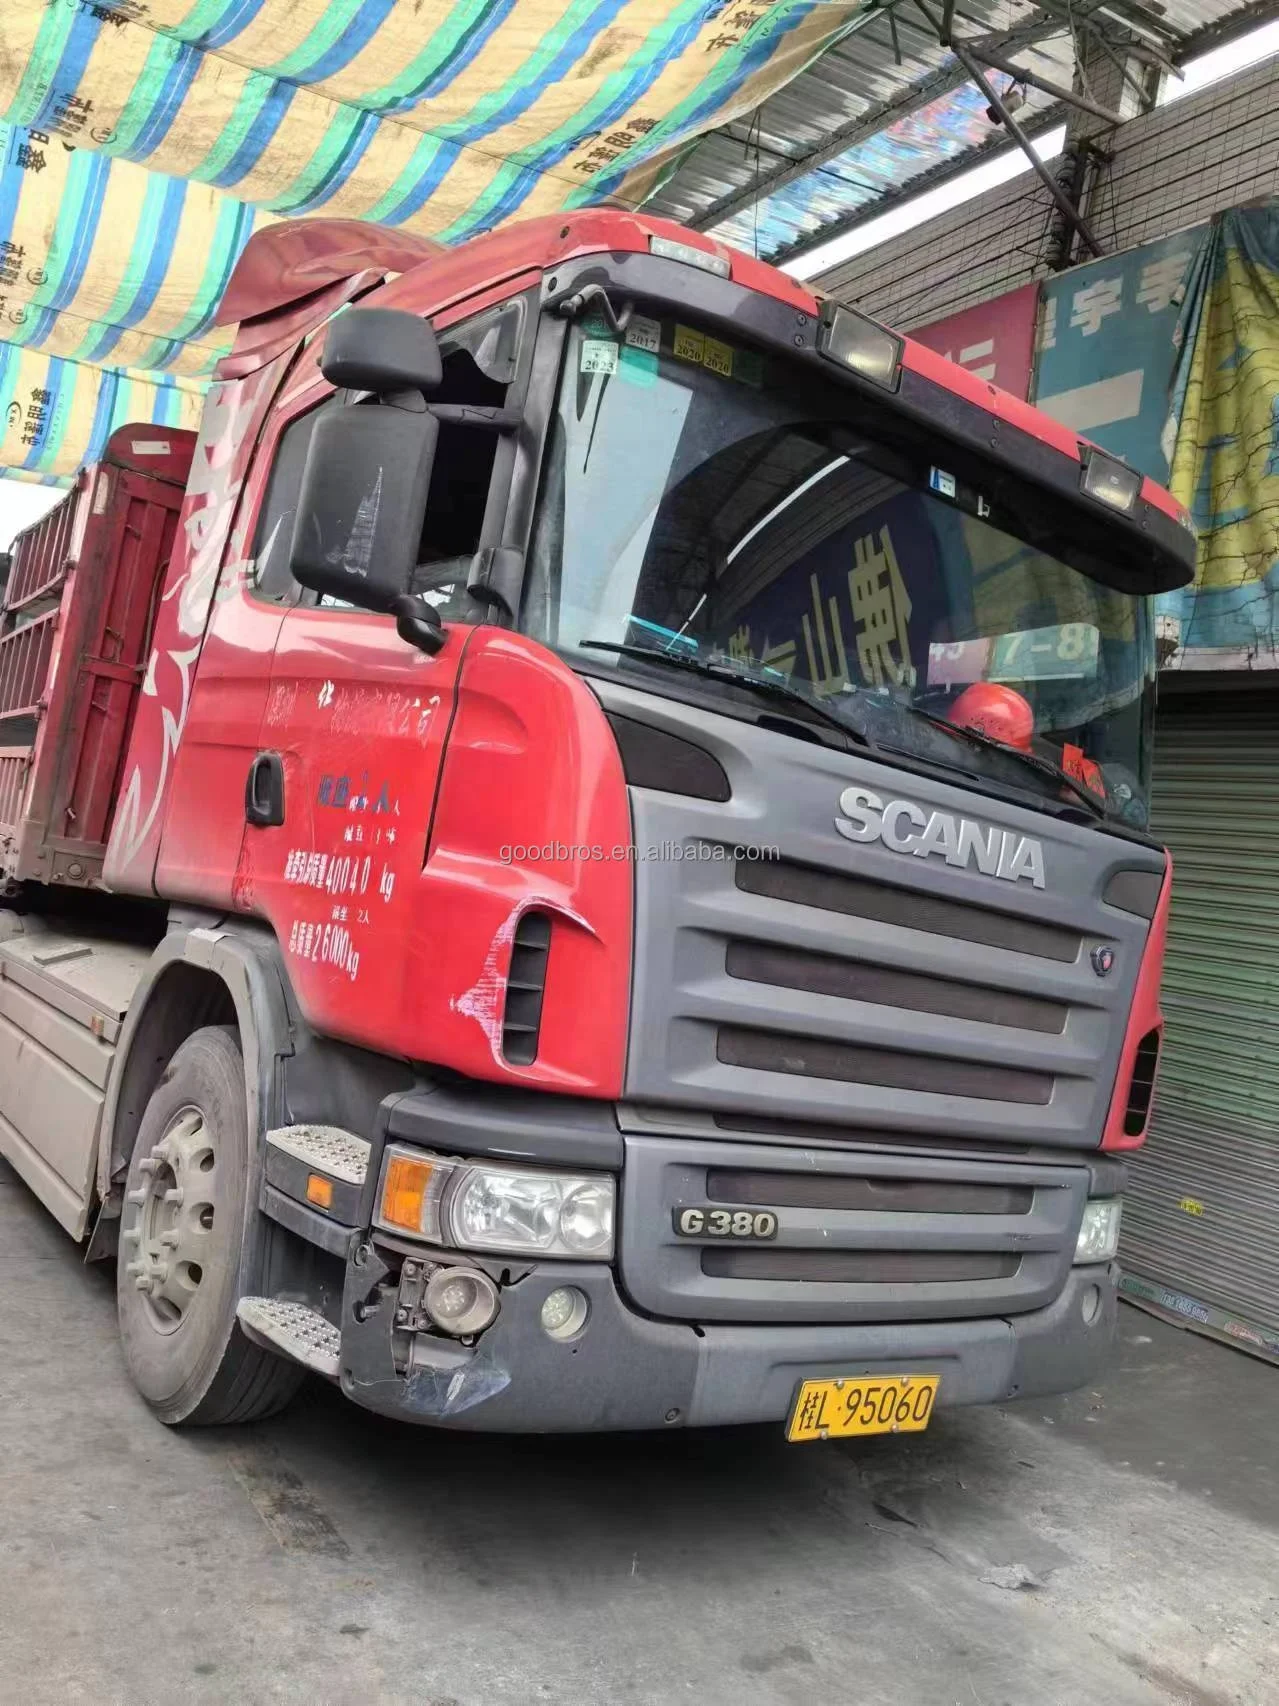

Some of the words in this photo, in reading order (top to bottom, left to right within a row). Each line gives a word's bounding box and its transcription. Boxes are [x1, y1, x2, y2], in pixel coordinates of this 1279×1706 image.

[834, 786, 1046, 890] SCANIA
[681, 1209, 704, 1234] G
[707, 1210, 775, 1237] 380
